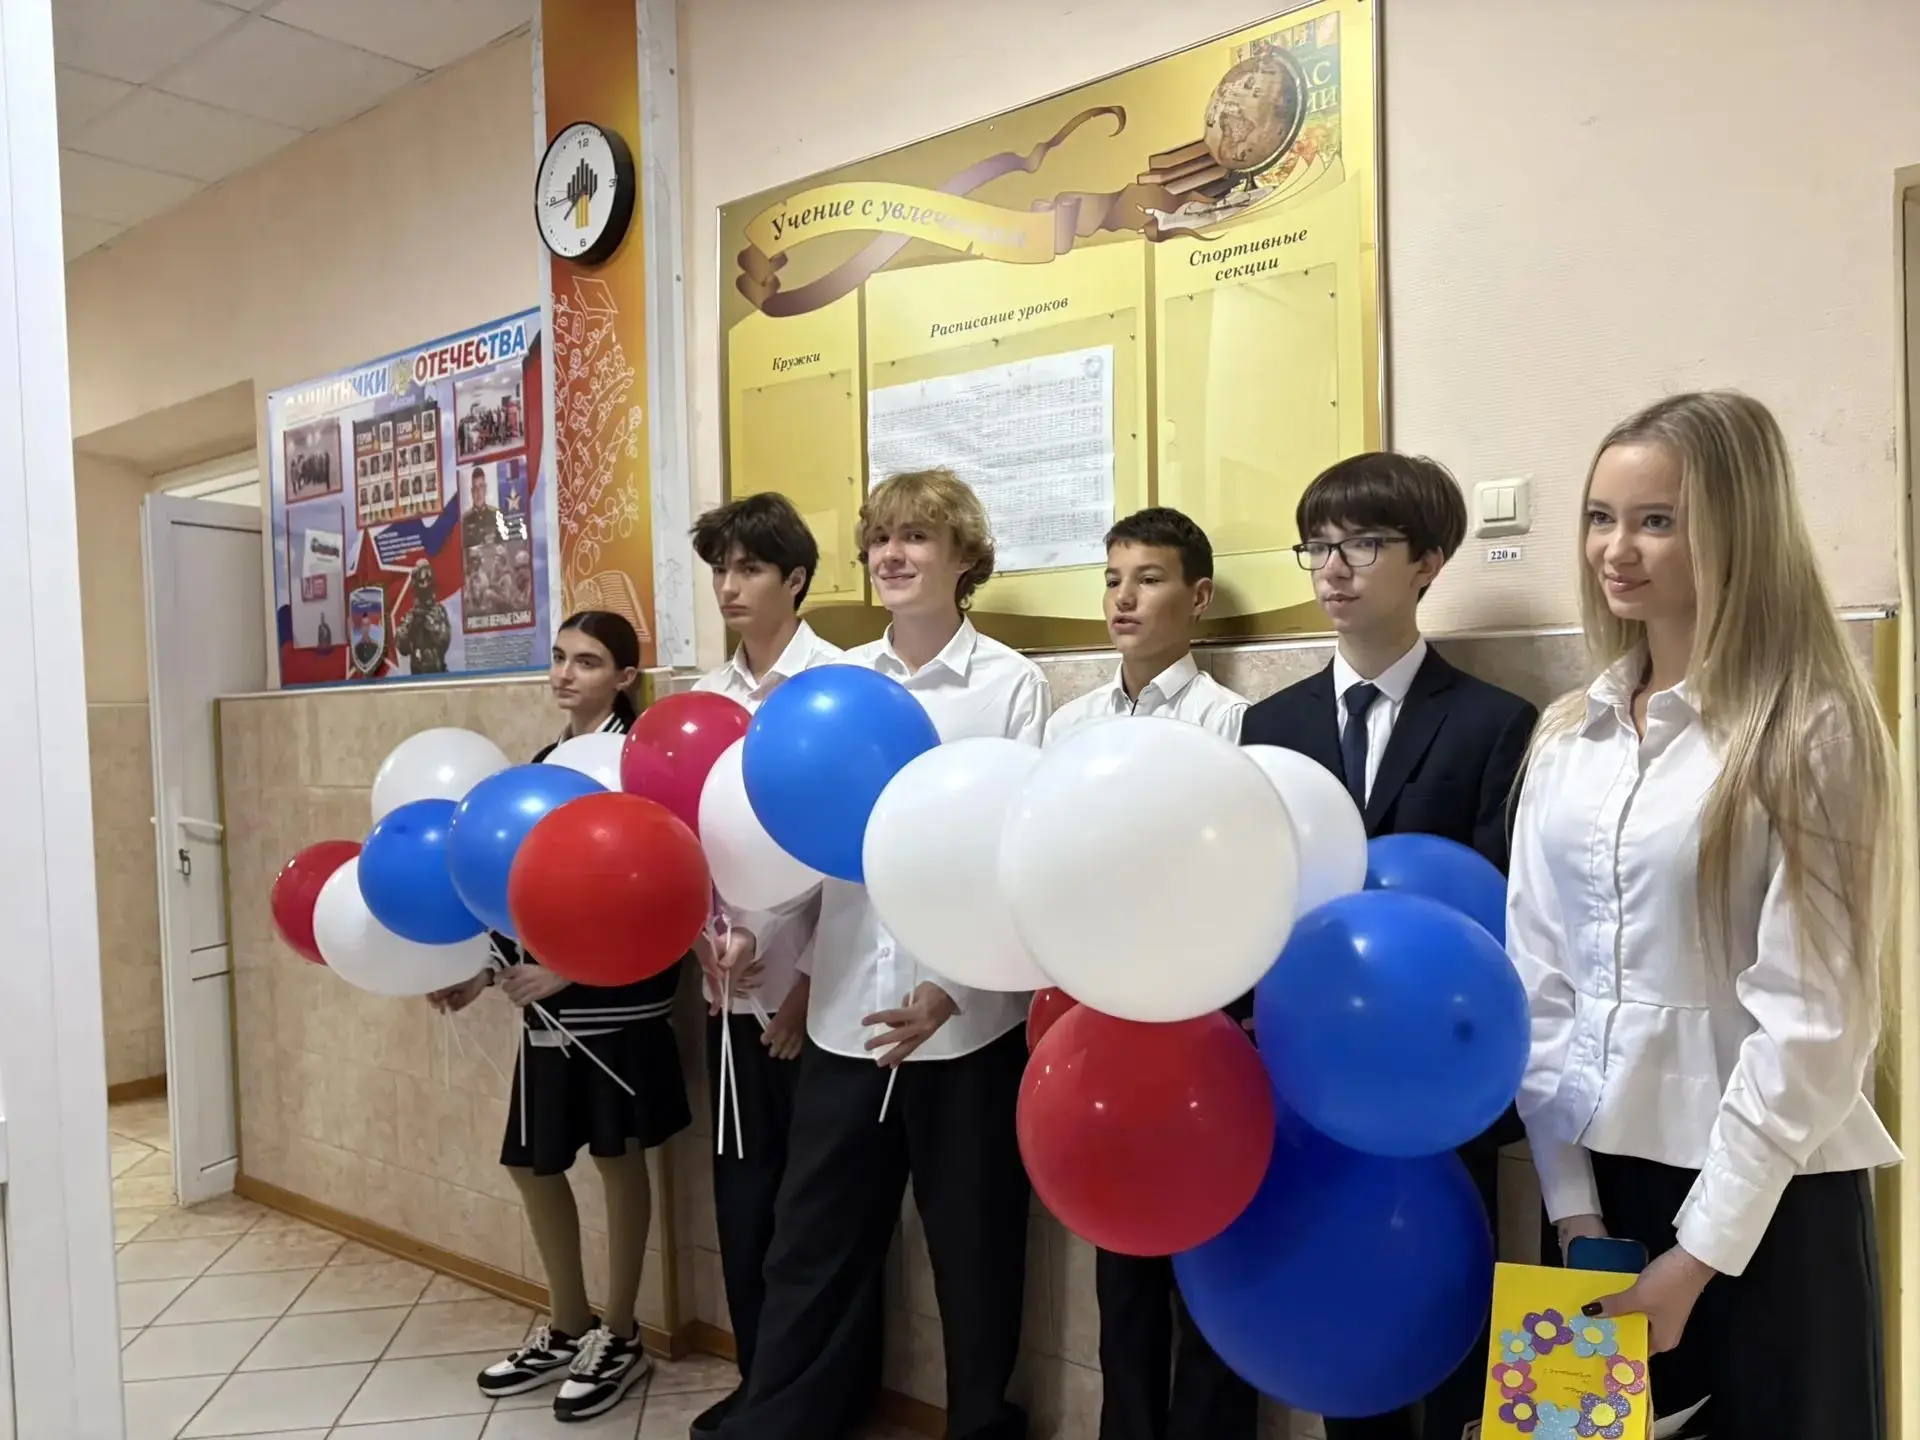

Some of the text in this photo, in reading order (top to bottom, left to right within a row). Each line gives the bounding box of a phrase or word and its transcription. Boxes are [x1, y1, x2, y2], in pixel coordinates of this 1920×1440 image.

[578, 137, 590, 150] 12
[771, 198, 855, 241] Учение
[860, 199, 874, 216] с
[579, 237, 588, 248] 6
[1189, 229, 1308, 267] Спортивные
[1215, 257, 1280, 282] секции
[930, 297, 1069, 338] Расписание уроков
[414, 324, 526, 382] ОТЕЧЕСТВА
[772, 352, 821, 373] Кружки
[1490, 550, 1508, 560] 220
